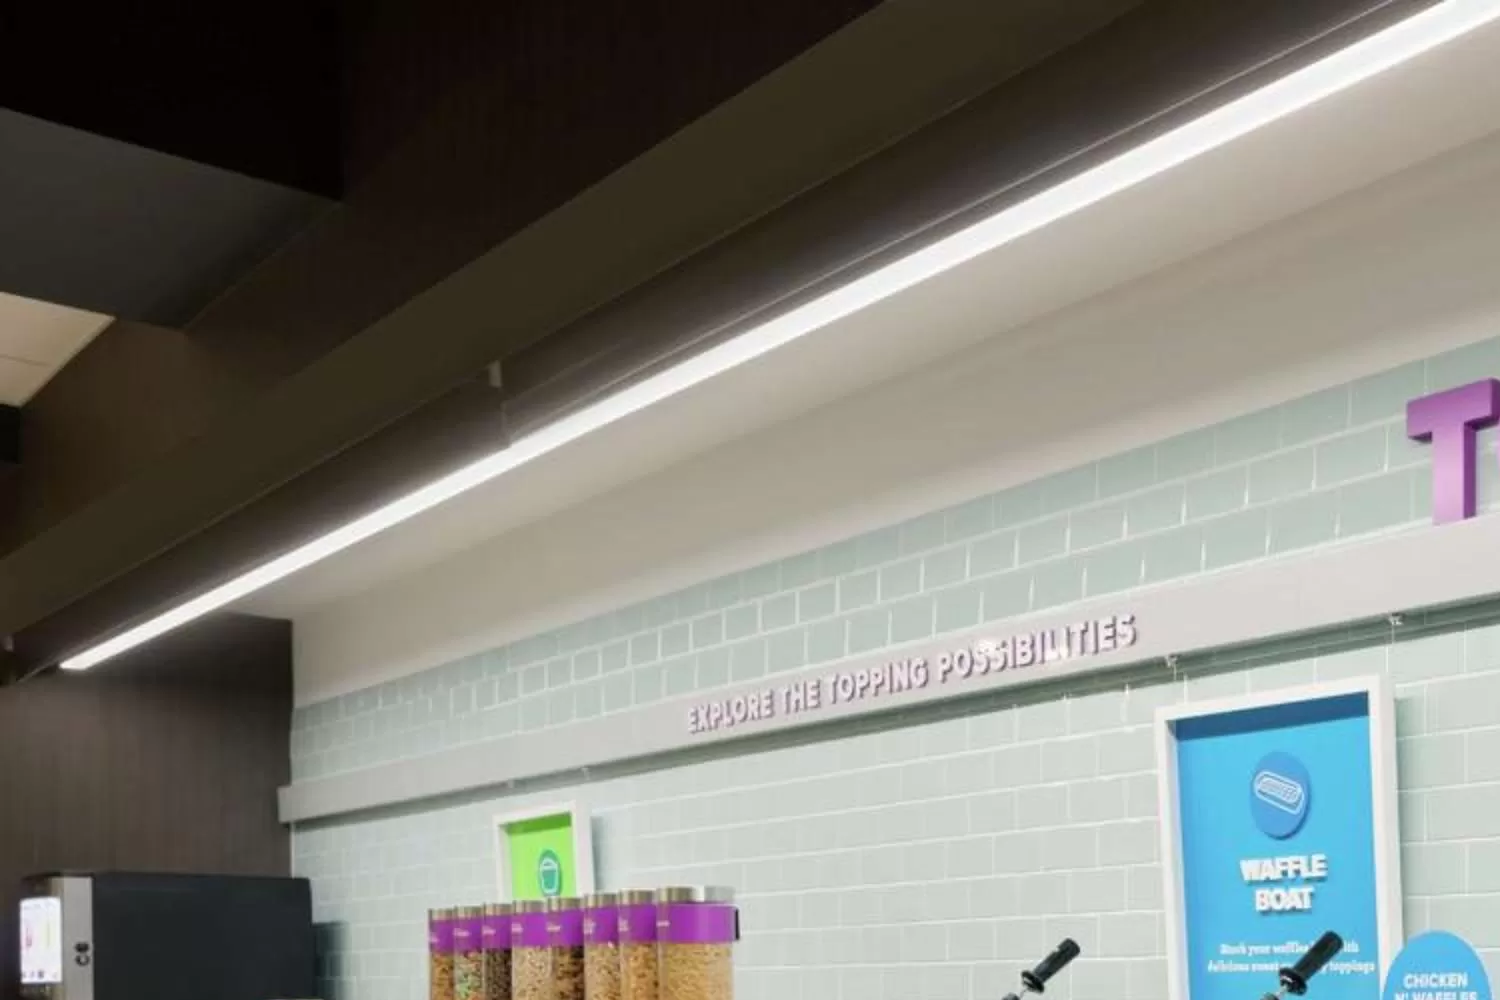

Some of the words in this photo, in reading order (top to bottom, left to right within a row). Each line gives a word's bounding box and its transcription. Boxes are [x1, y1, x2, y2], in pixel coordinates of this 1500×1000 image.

[688, 690, 775, 734] EXPLORE
[780, 679, 821, 712] THE
[829, 656, 930, 702] TOPPING
[938, 613, 1138, 678] POSSIBILITIES
[1240, 854, 1328, 881] WAFFLE
[1255, 887, 1314, 912] BOAT
[1403, 972, 1468, 989] CHICKEN
